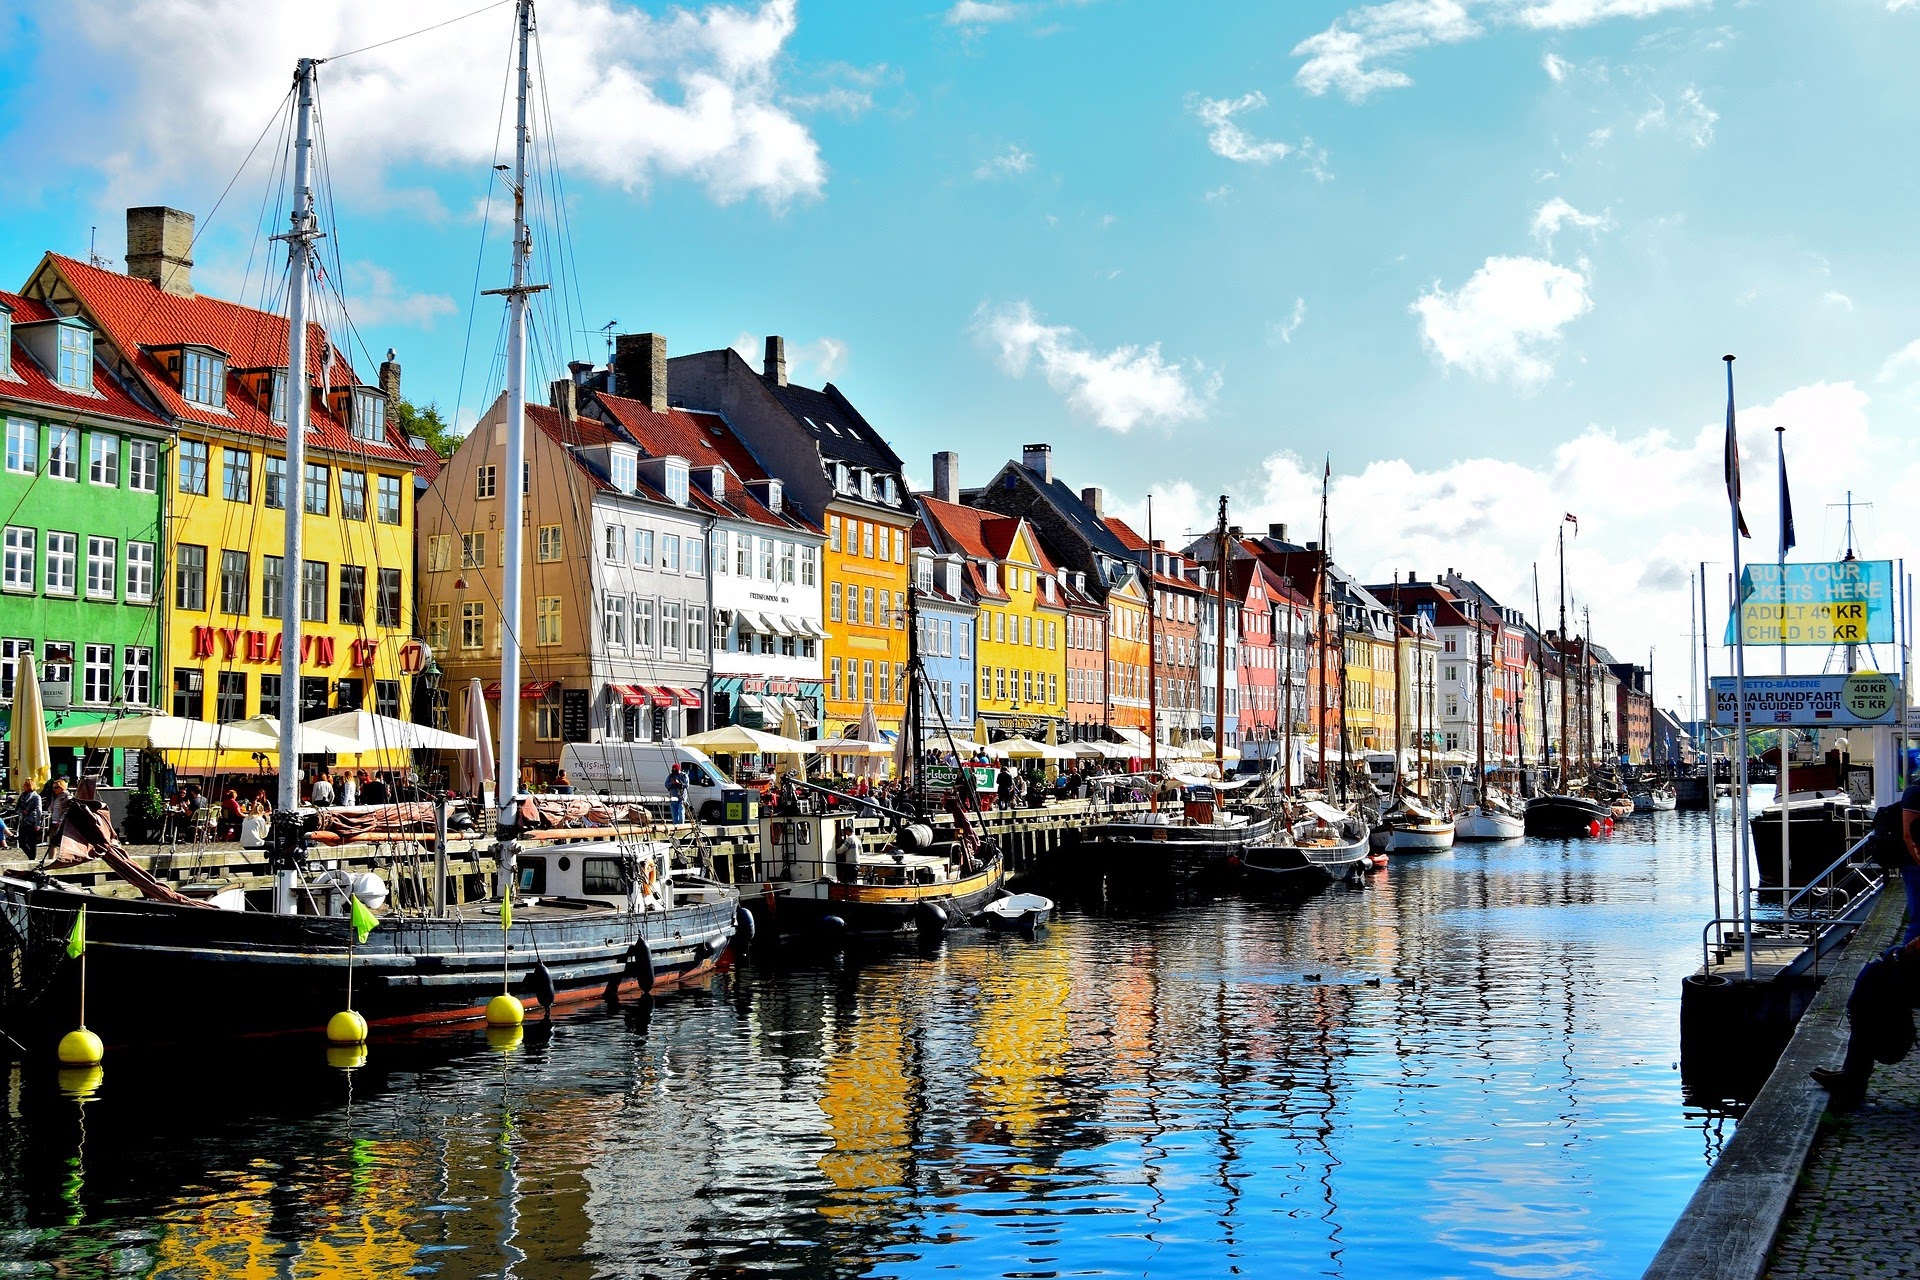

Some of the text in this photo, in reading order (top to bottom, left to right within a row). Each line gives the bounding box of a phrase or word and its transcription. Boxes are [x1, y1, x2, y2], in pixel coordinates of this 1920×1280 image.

[1751, 564, 1860, 582] BUY YOUR
[1826, 581, 1882, 599] HERE
[1746, 604, 1863, 620] ADULT 40 KR
[1746, 625, 1858, 639] CHILD 15 KR
[352, 638, 379, 668] 17
[399, 645, 422, 672] 17
[1743, 679, 1820, 689] ETTO-BÅDENE
[1854, 684, 1887, 693] 40 KR
[1718, 703, 1732, 711] 60
[1759, 702, 1804, 711] GUIDED
[1808, 701, 1841, 710] TOUR
[1851, 700, 1886, 709] 15 KR
